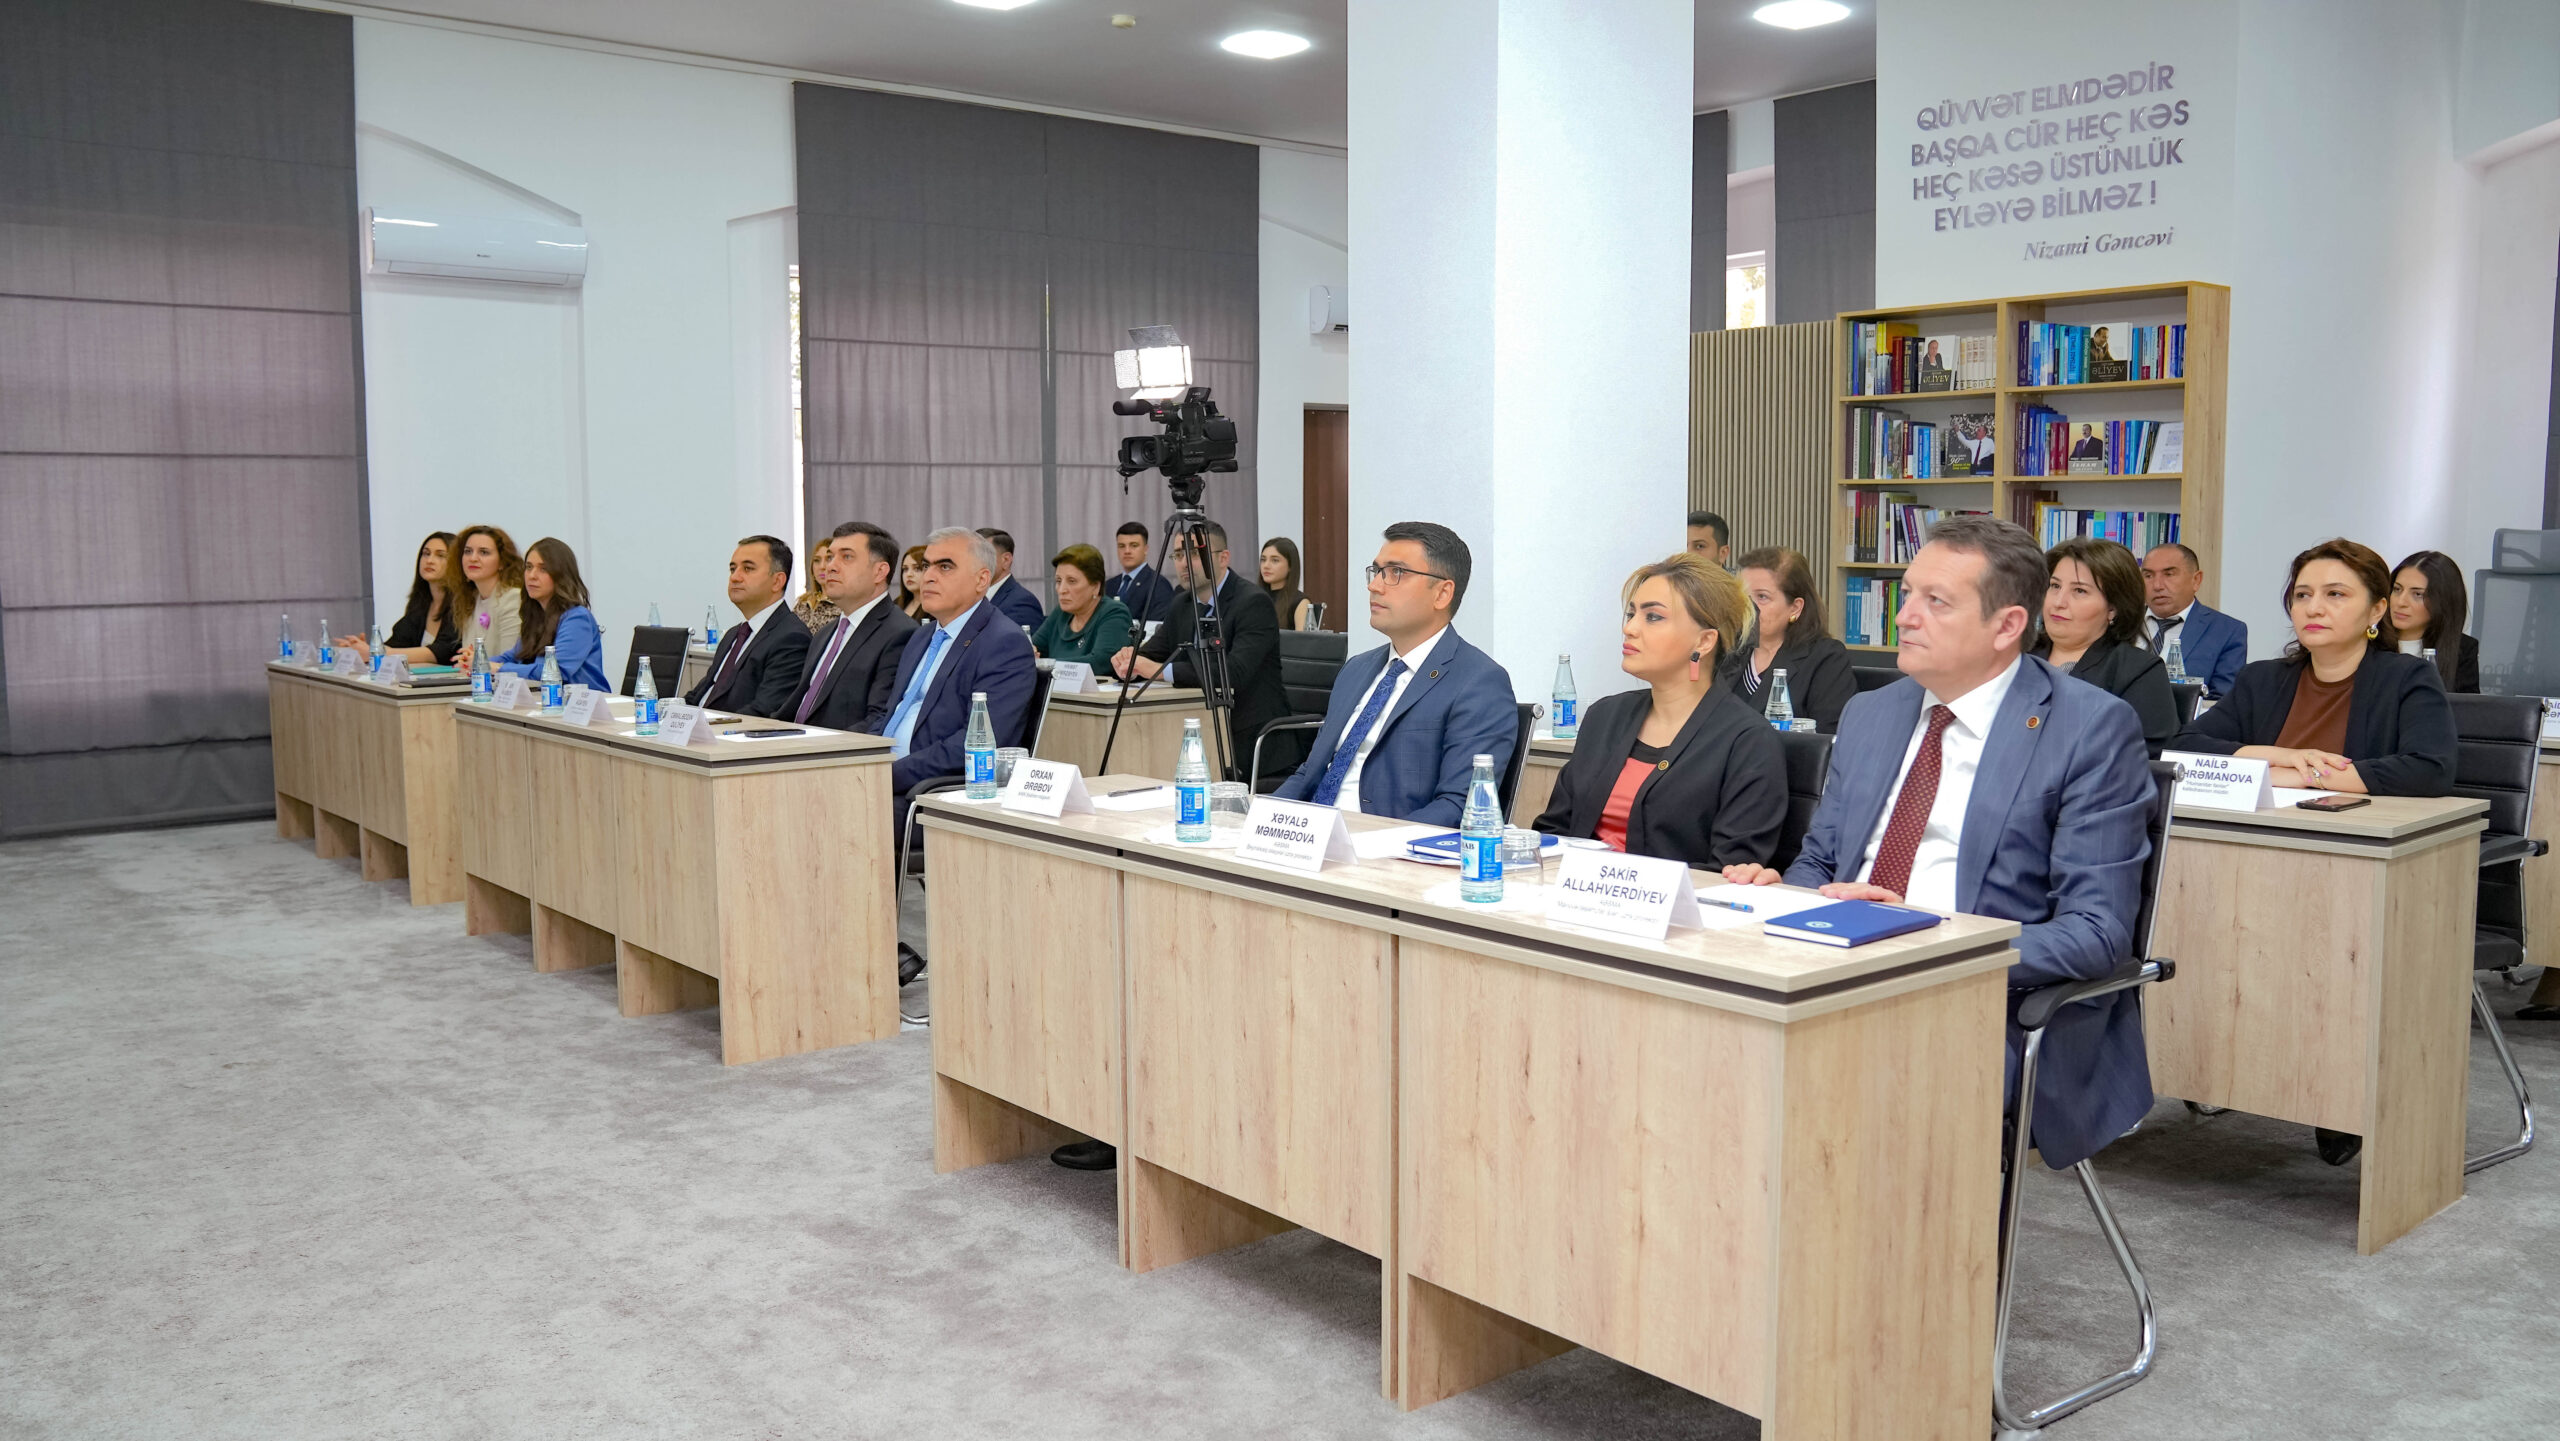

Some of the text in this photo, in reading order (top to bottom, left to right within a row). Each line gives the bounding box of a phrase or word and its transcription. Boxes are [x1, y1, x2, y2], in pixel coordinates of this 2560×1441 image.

[1917, 61, 2175, 131] QÜVVƏT ELMDƏDİR
[1911, 99, 2190, 167] BAŞQA CÜR HEÇ KƏS
[1913, 136, 2185, 202] HEÇ KƏSƏ ÜSTÜNLÜK
[1934, 197, 2035, 232] EYLƏYƏ
[2042, 181, 2142, 218] BİLMƏZ
[2023, 226, 2175, 261] Nizami Gəncəvi
[2195, 758, 2229, 769] NAİLƏ
[1030, 769, 1054, 781] ORXAN
[2184, 769, 2253, 784] HRƏMANOVA
[1023, 781, 1053, 793] ƏRƏBOV
[1270, 812, 1309, 828] XƏYALƏ
[1255, 824, 1315, 844] MƏMMƏDOVA
[1599, 865, 1638, 882] ŞAKİR
[1562, 877, 1668, 905] ALLAHVERDİYEV
